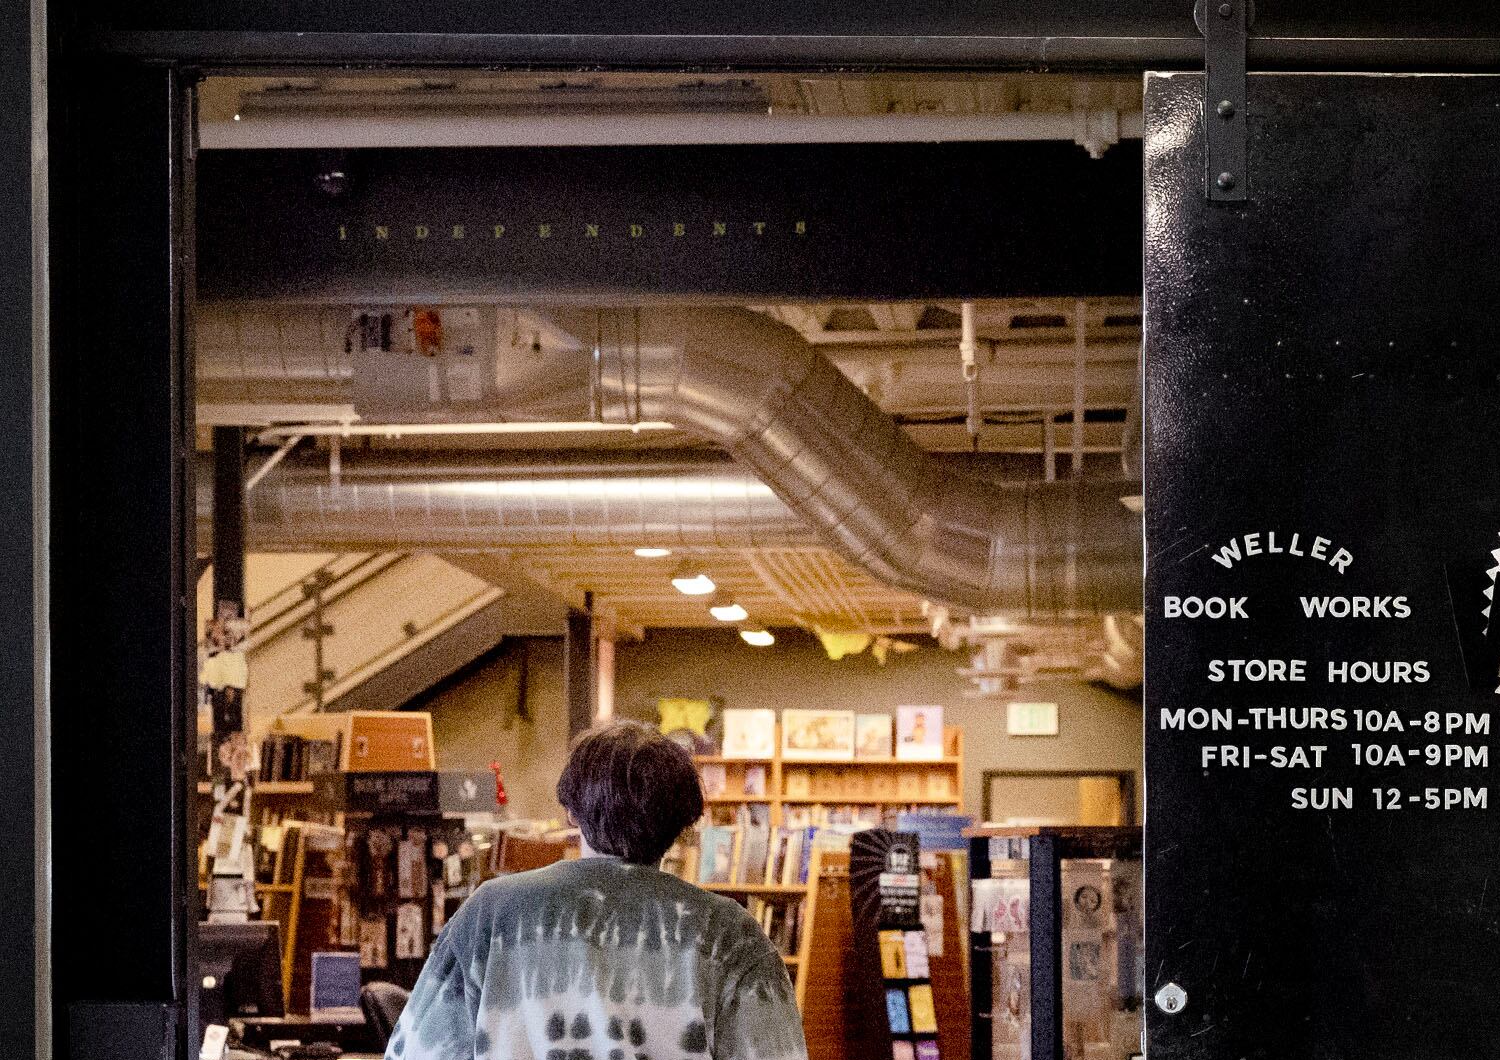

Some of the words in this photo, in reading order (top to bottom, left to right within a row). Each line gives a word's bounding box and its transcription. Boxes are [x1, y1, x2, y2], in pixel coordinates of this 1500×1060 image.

[338, 220, 807, 241] INDEPENDENTS
[1212, 530, 1354, 575] WELLER
[1163, 596, 1249, 619] BOOK
[1300, 596, 1412, 619] WORKS
[1207, 659, 1307, 682] STORE
[1328, 661, 1431, 684] HOURS
[1159, 707, 1348, 731] MON-THURS
[1353, 710, 1491, 735] 10A-8PM
[1201, 745, 1328, 769] FRI-SAT
[1351, 744, 1490, 768] 10A-9PM
[1291, 787, 1354, 810] SUN
[1372, 787, 1488, 810] 12-5PM
